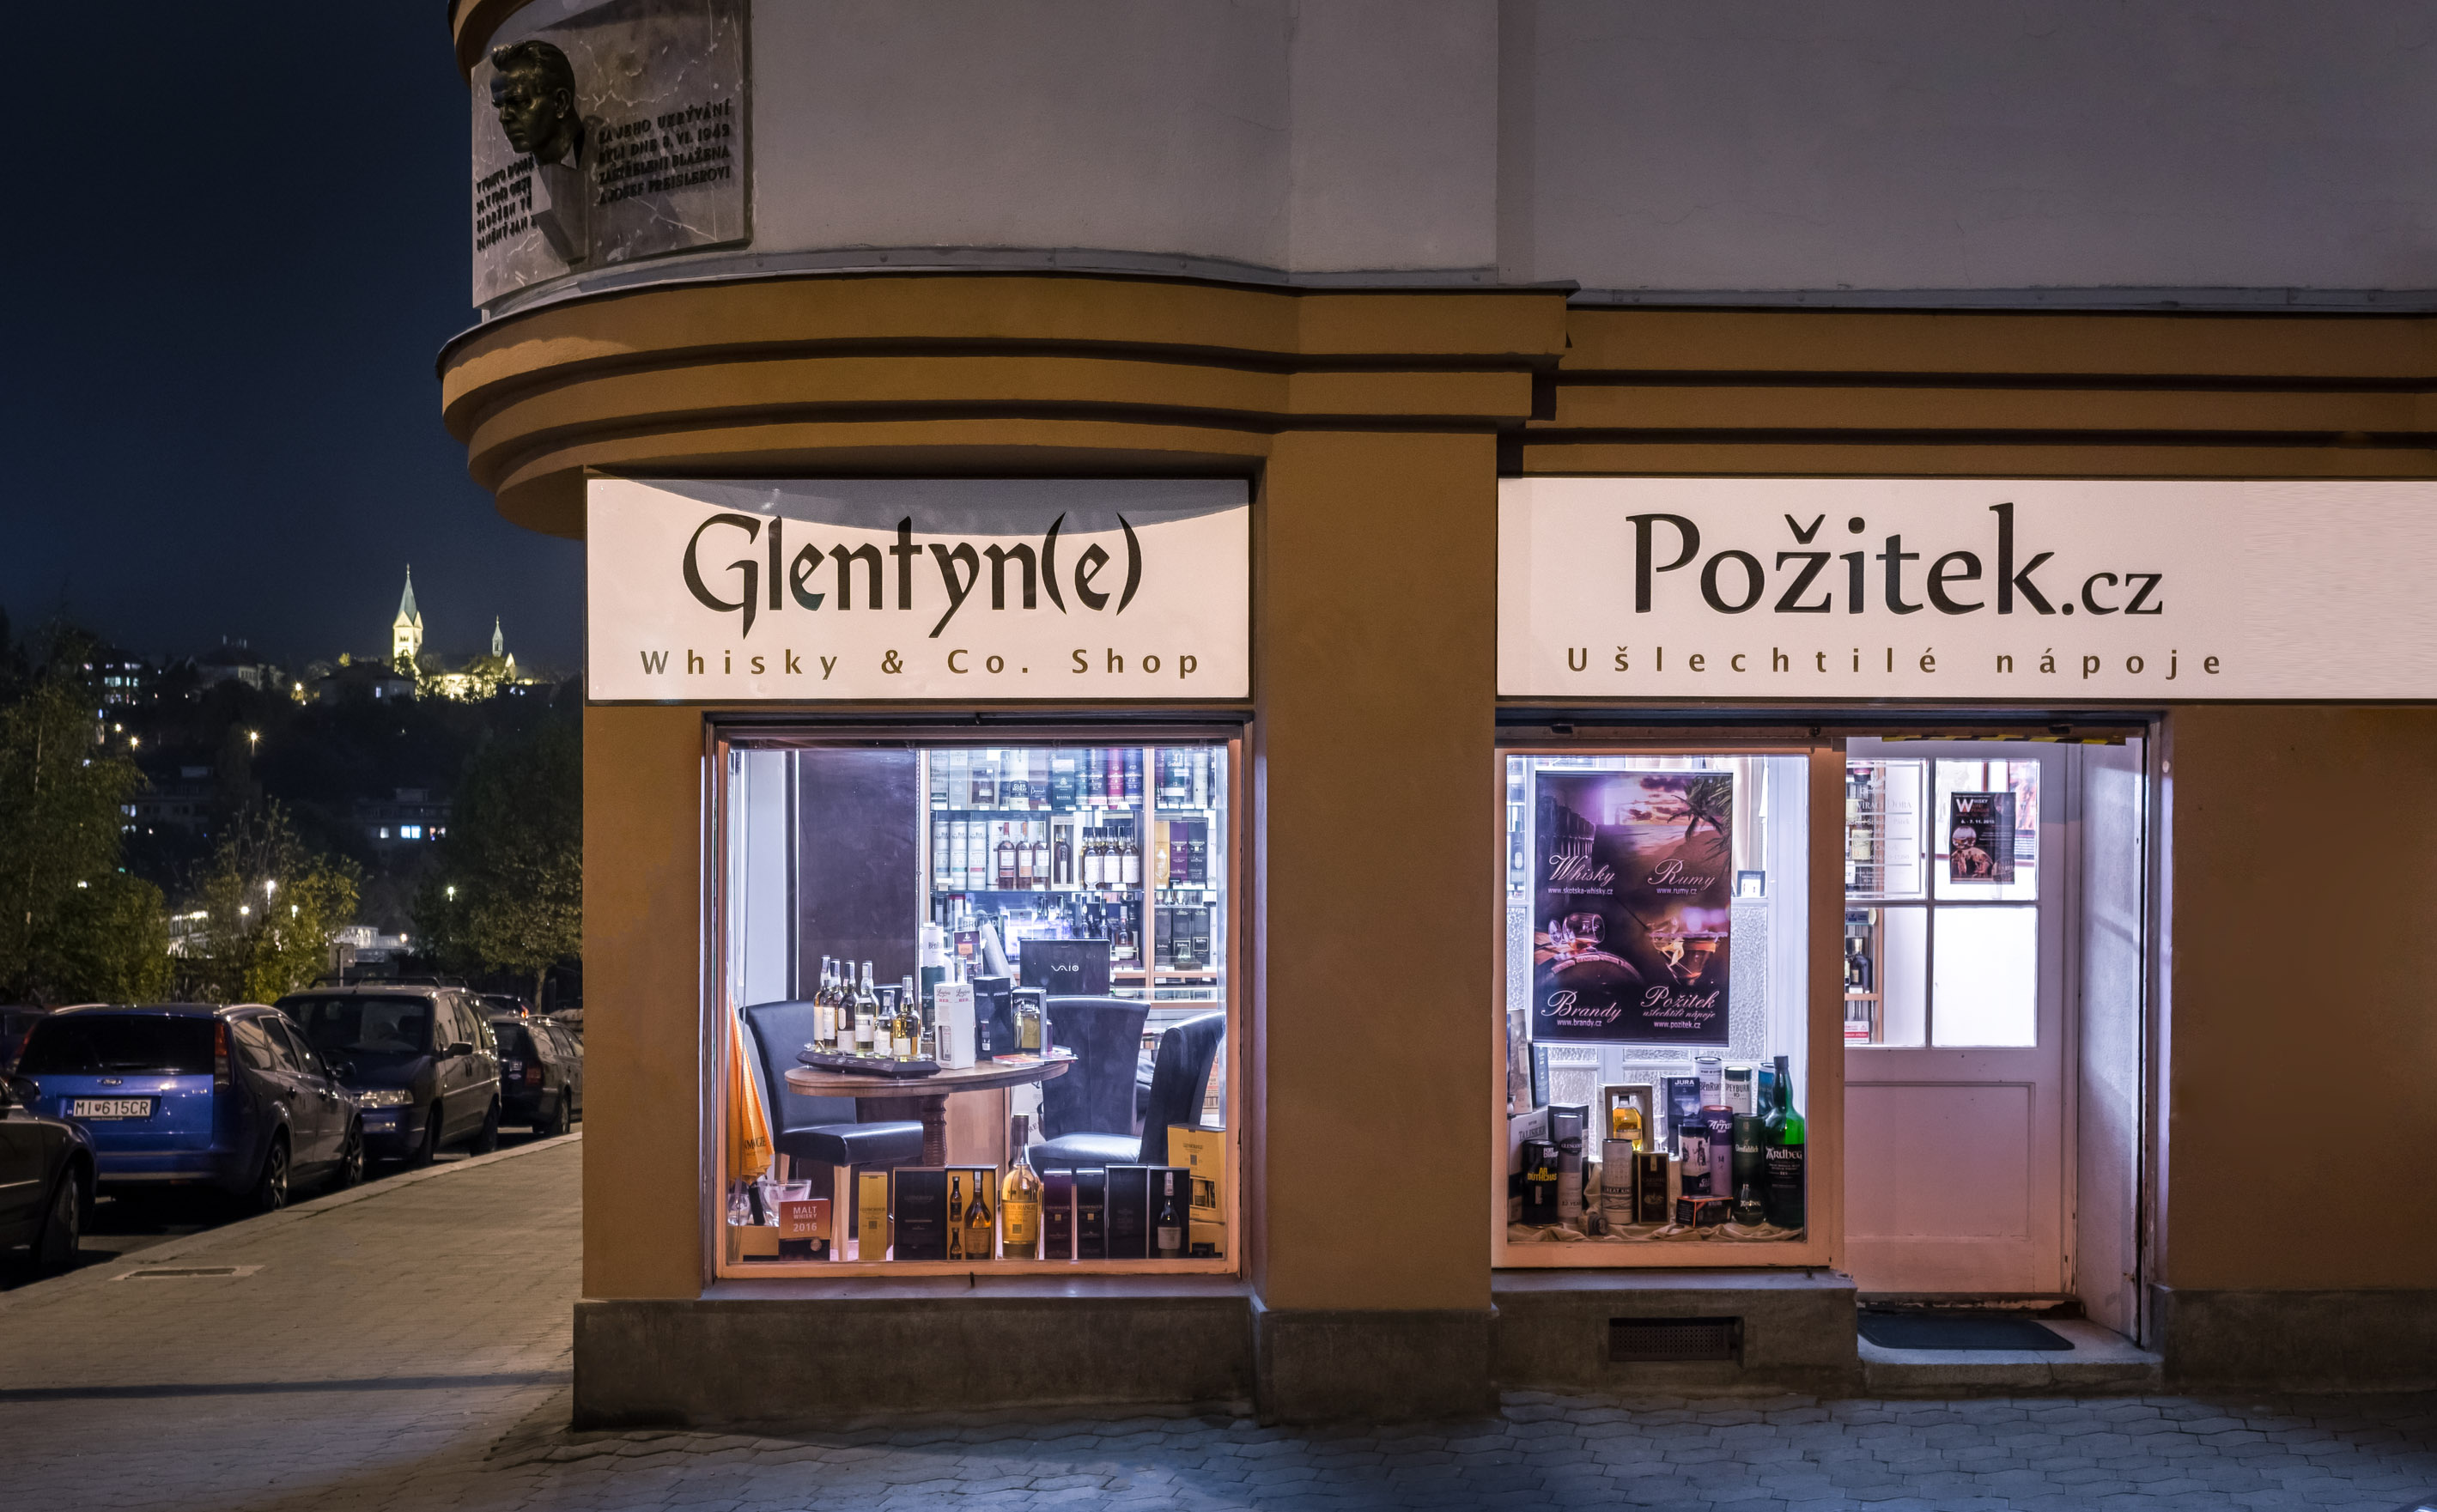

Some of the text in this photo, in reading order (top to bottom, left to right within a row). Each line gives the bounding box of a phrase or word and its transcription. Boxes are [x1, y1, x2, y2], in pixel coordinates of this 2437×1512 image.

[1625, 502, 2164, 616] Požitek.cz
[683, 511, 1143, 640] Glentyn(e)
[640, 647, 1199, 679] Whisky & Co. Shop
[1566, 646, 2221, 681] Ušlechtilé nápoje
[1548, 855, 1615, 887] Whisky
[1647, 859, 1717, 891] Rumy
[1656, 887, 1698, 896] www.rumy.cz
[1541, 990, 1622, 1023] Brandy
[1639, 986, 1720, 1009] Požitek
[1556, 1017, 1602, 1027] www.brandy.cz
[1654, 1020, 1701, 1029] www.pozitek.cz
[1725, 1084, 1750, 1093] PEYBURN
[76, 1101, 149, 1114] MI 615CR
[793, 1223, 817, 1232] 2016
